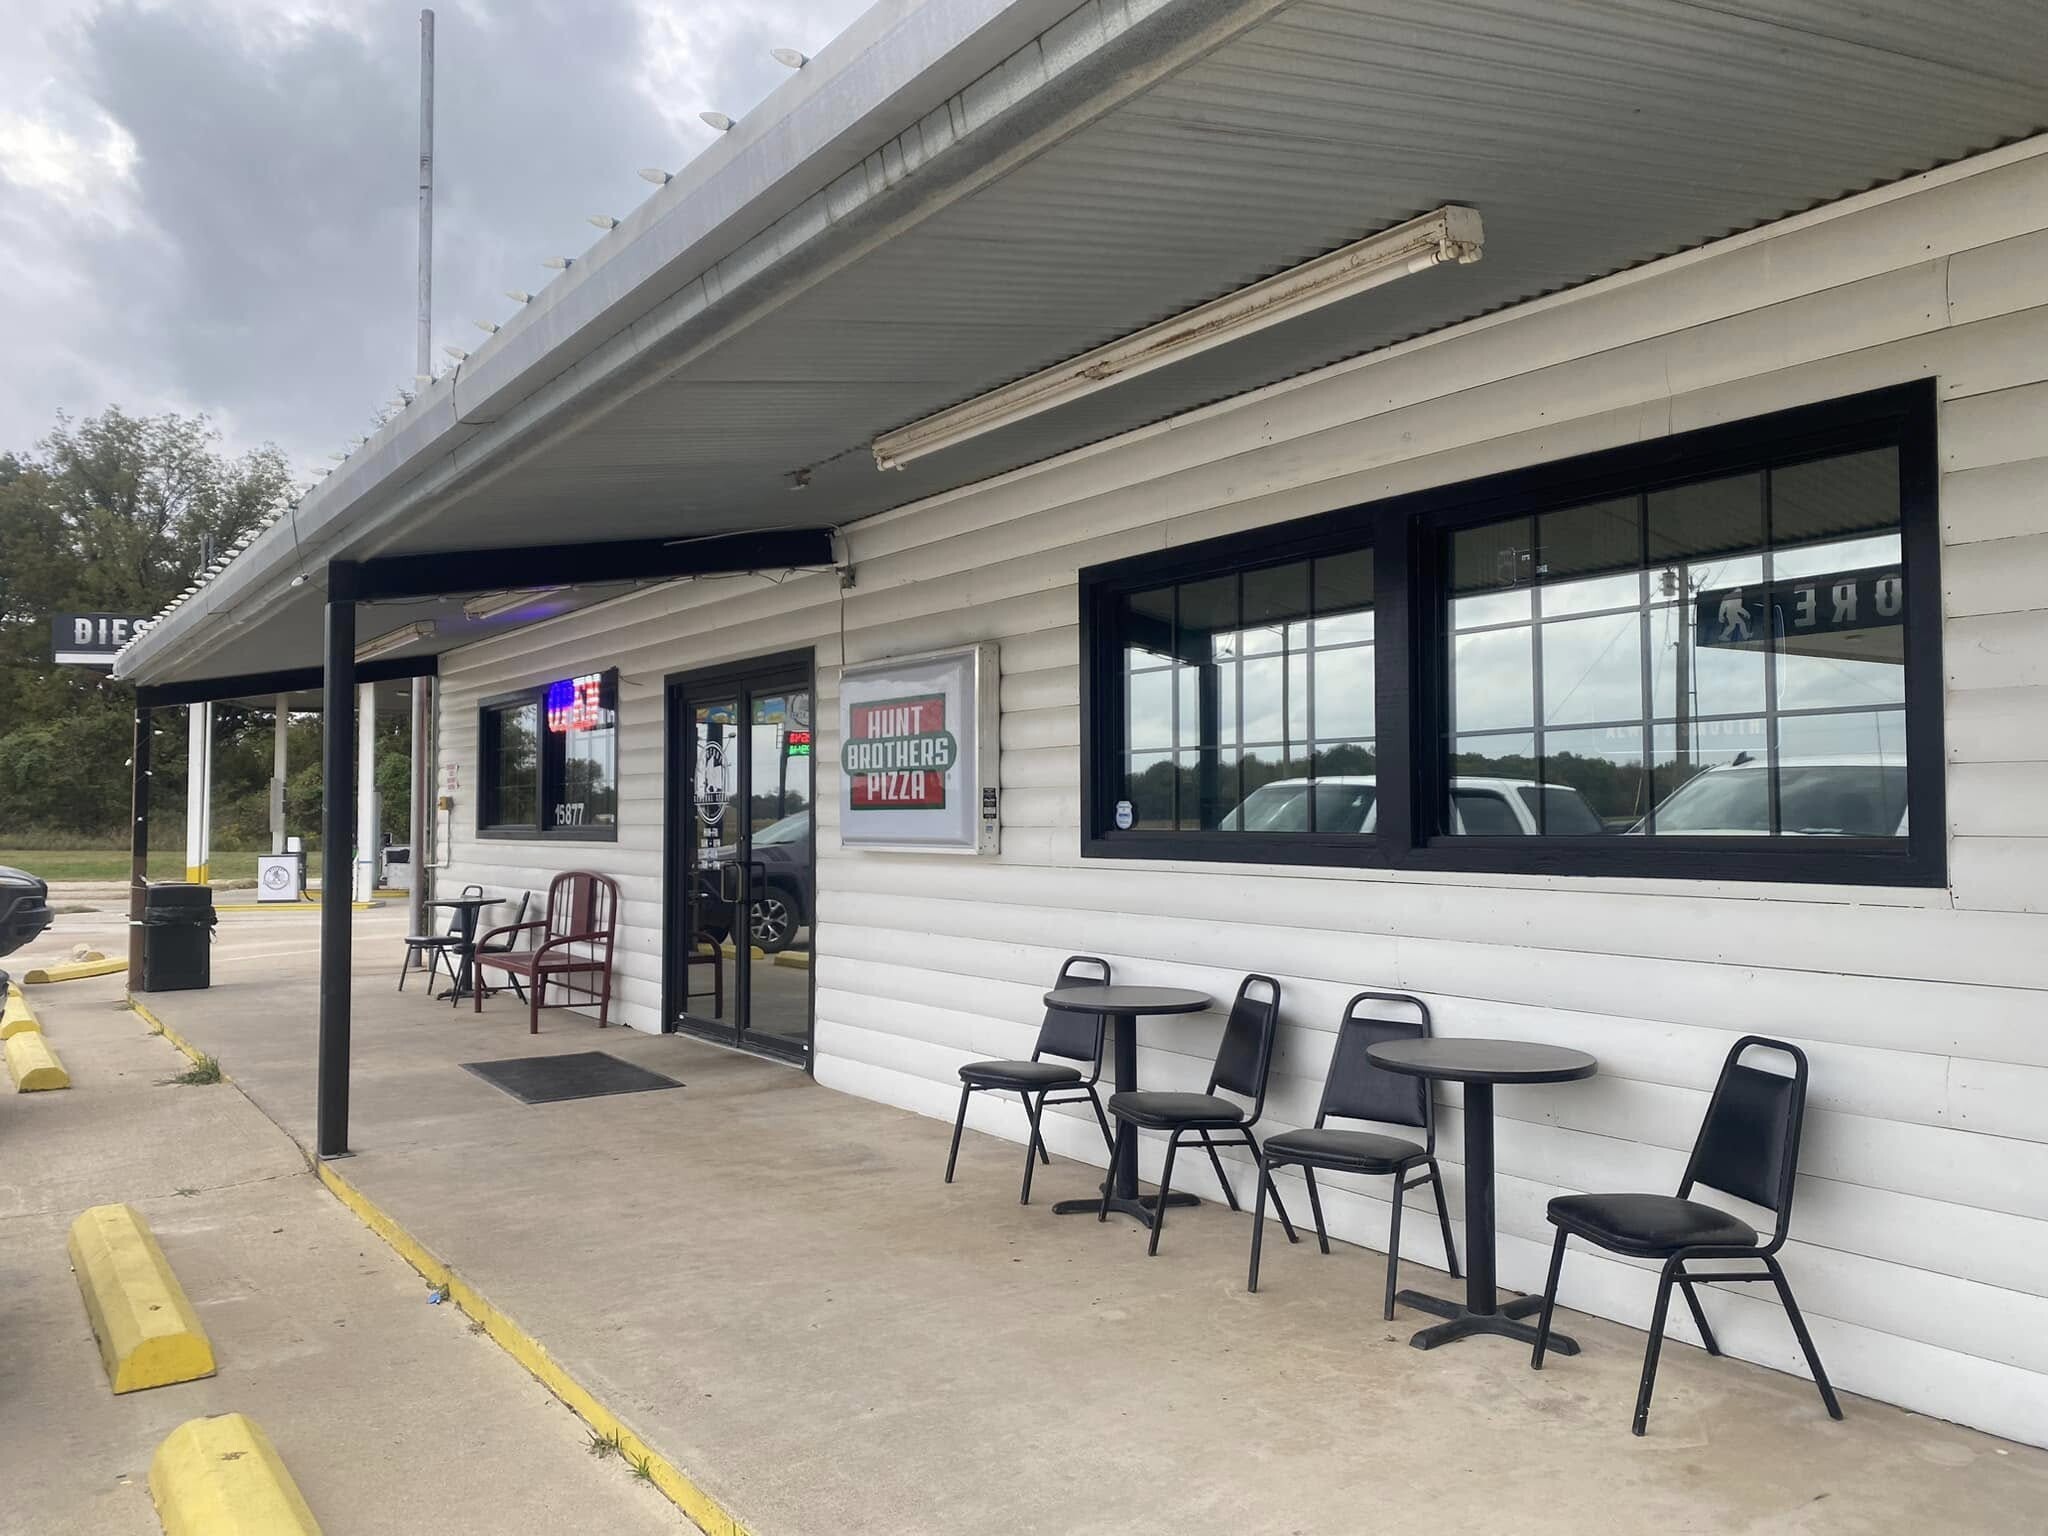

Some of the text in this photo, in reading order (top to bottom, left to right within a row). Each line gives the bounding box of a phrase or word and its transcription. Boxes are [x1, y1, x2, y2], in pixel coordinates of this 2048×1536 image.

[867, 705, 923, 739] HUNT
[847, 737, 949, 770] BROTHERS
[867, 770, 925, 801] PIZZA
[554, 802, 585, 826] 15877
